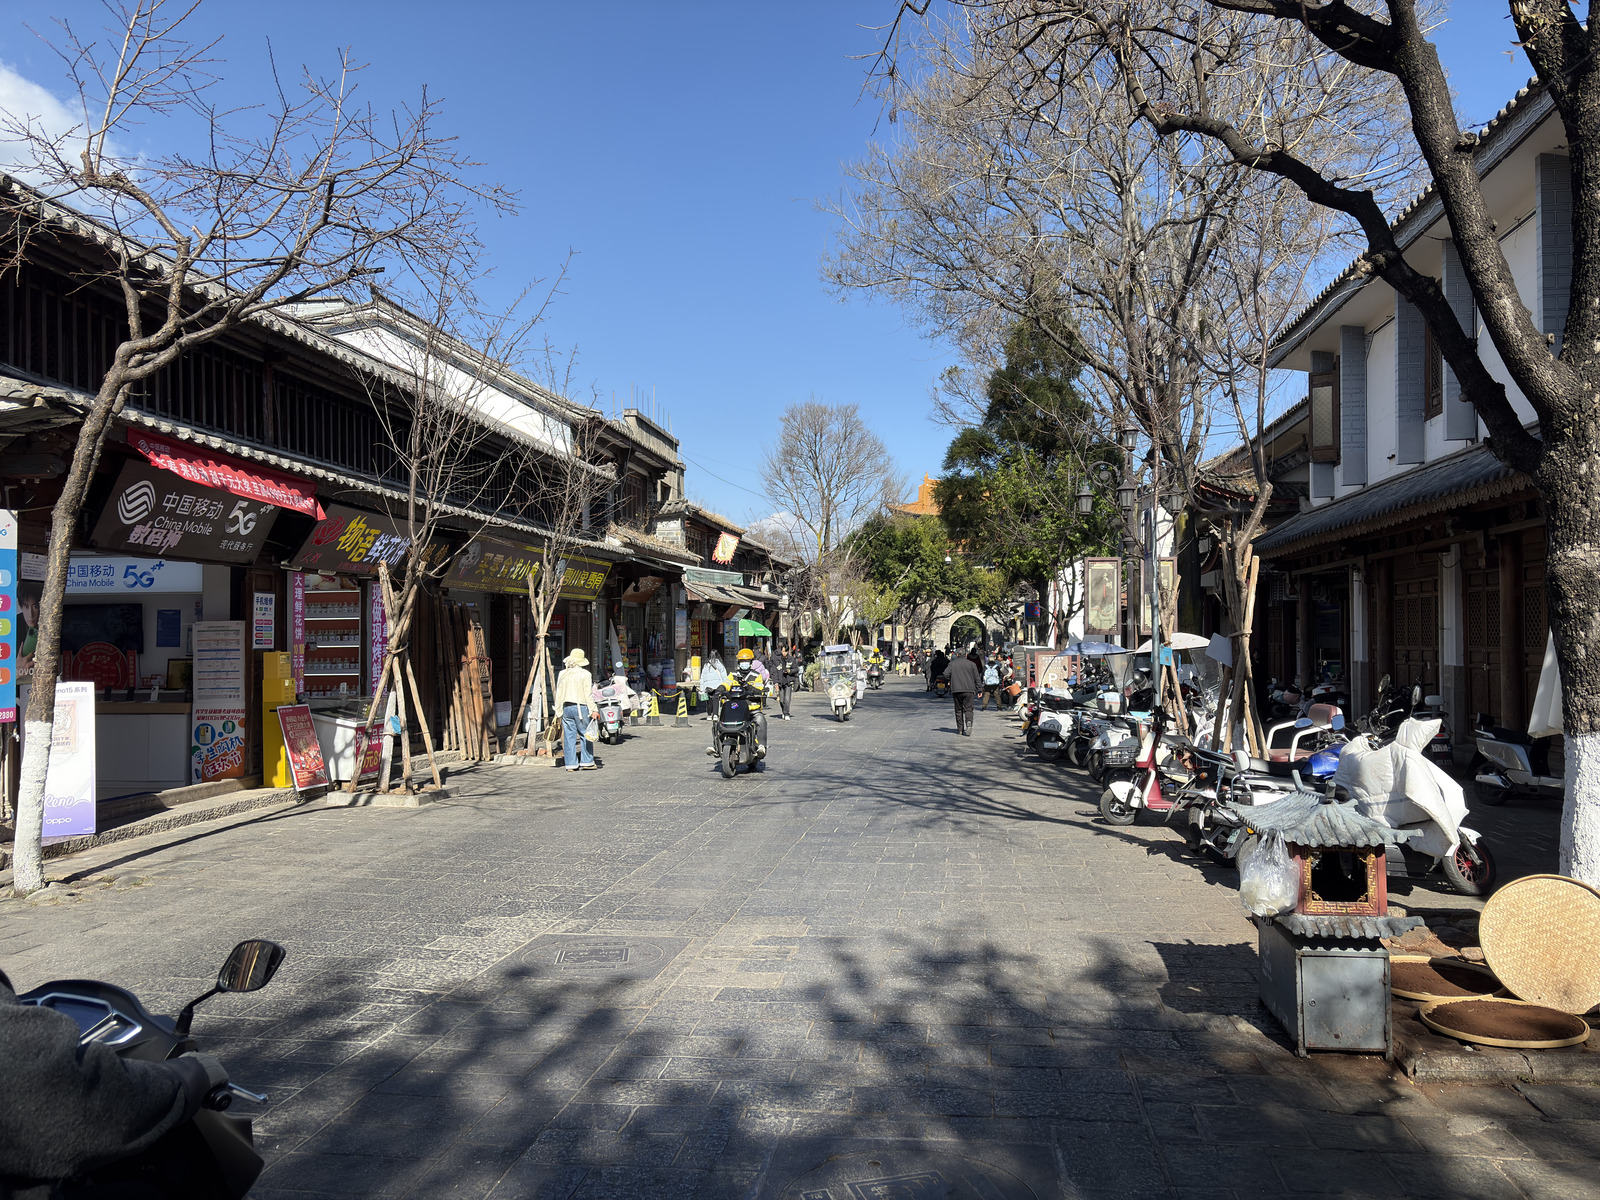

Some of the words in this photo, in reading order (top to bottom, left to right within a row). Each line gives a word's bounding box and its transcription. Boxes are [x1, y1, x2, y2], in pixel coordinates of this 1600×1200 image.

[162, 491, 224, 520] 中国移动
[127, 521, 184, 555] 数码狮
[154, 515, 183, 531] China
[184, 520, 213, 536] Mobile
[66, 579, 88, 588] China
[89, 579, 115, 588] Mobile
[67, 564, 115, 578] 中国移动
[294, 573, 303, 640] 大理鲜花饼
[194, 736, 243, 764] 学生购机
[204, 752, 241, 777] 狂欢节
